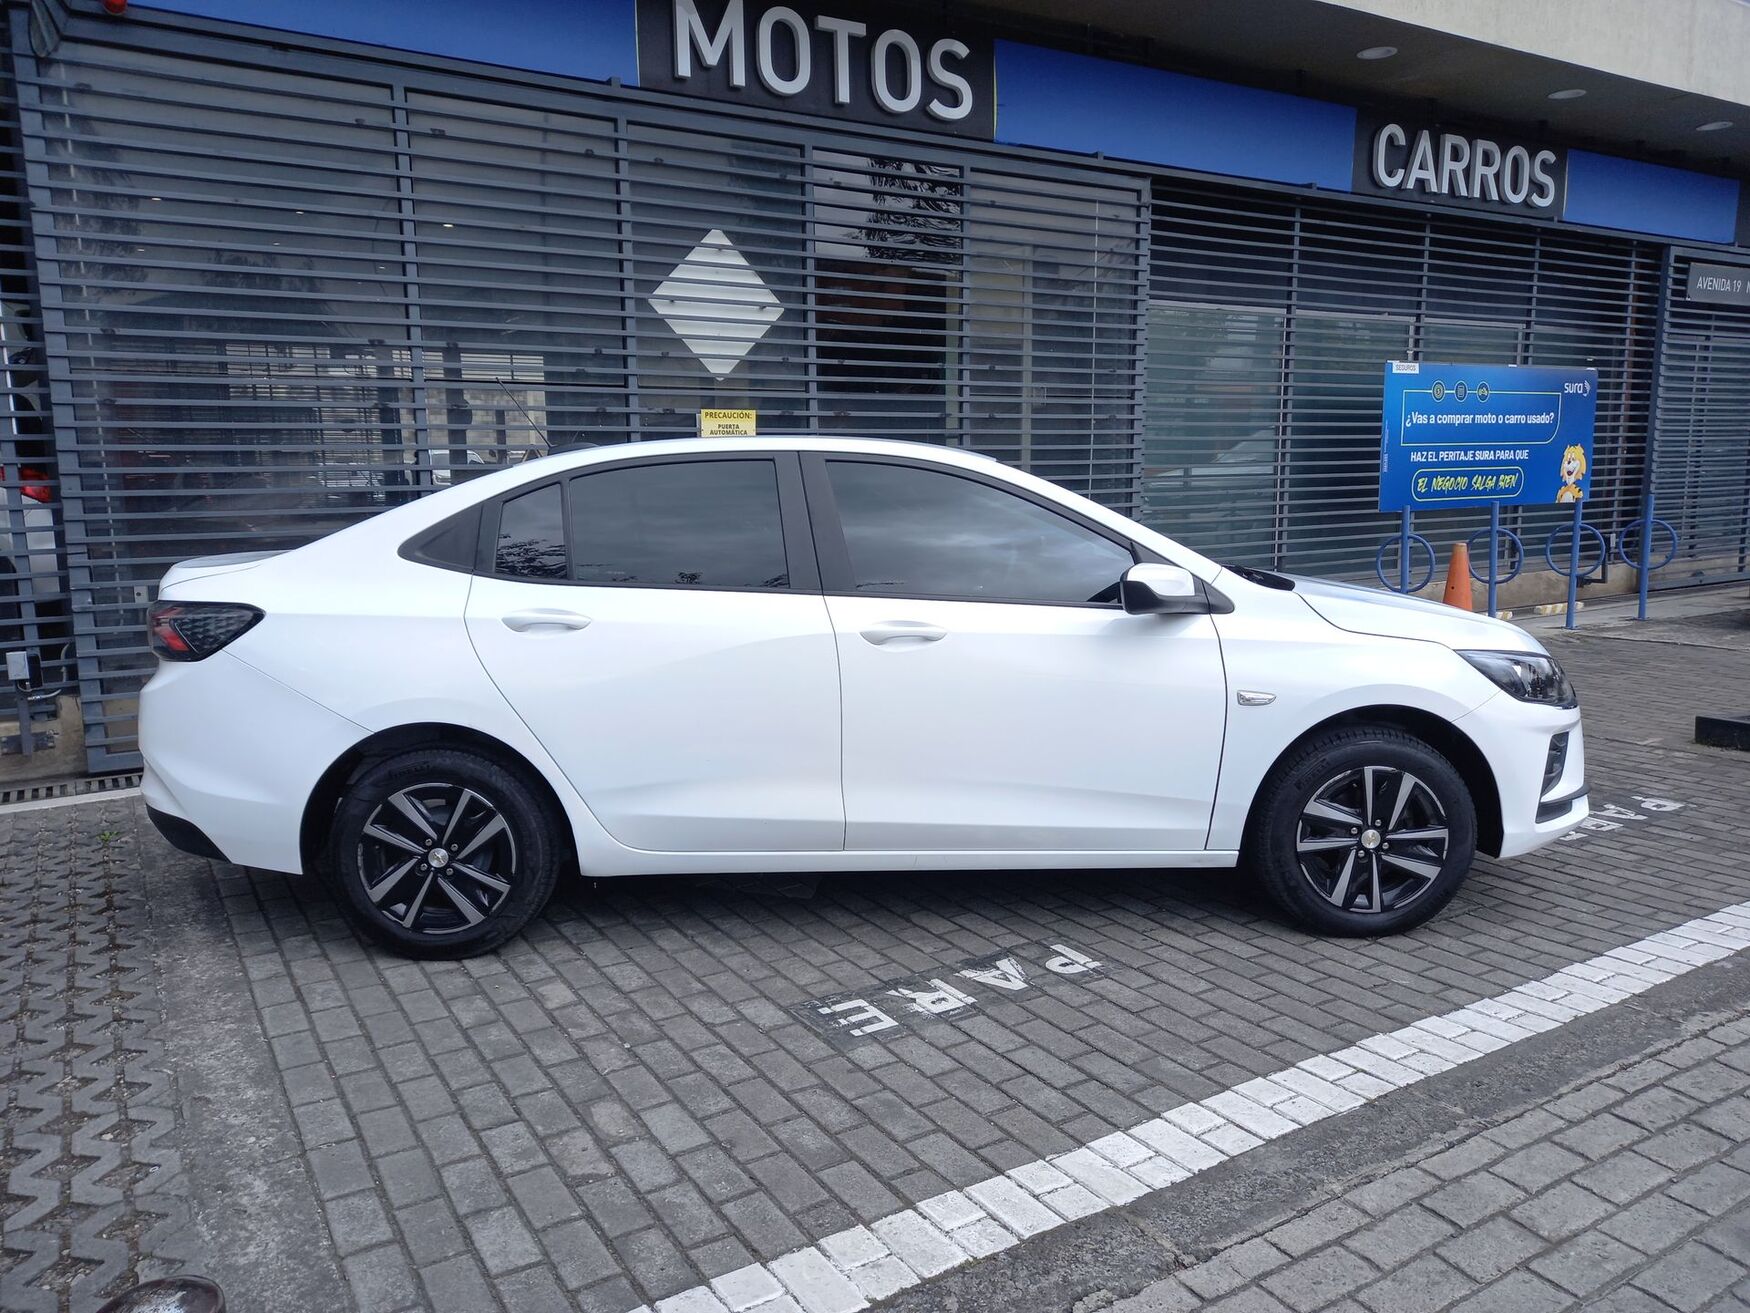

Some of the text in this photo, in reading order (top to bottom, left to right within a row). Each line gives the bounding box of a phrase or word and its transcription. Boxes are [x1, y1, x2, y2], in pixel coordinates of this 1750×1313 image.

[672, 0, 973, 121] MOTOS
[1372, 123, 1557, 207] CARROS
[1696, 276, 1731, 292] AVENIDA
[1733, 280, 1742, 292] 19
[1564, 382, 1583, 394] sura
[704, 411, 753, 419] PRECAUCIÓN:
[1405, 411, 1555, 427] ¿Vas a comprar moto o carro usado?
[1410, 449, 1529, 462] HAZ EL PERITAJE SURA PARA QUE
[1417, 472, 1519, 494] EL NEGOCIO SALGA BIEN
[818, 943, 1102, 1037] PARE
